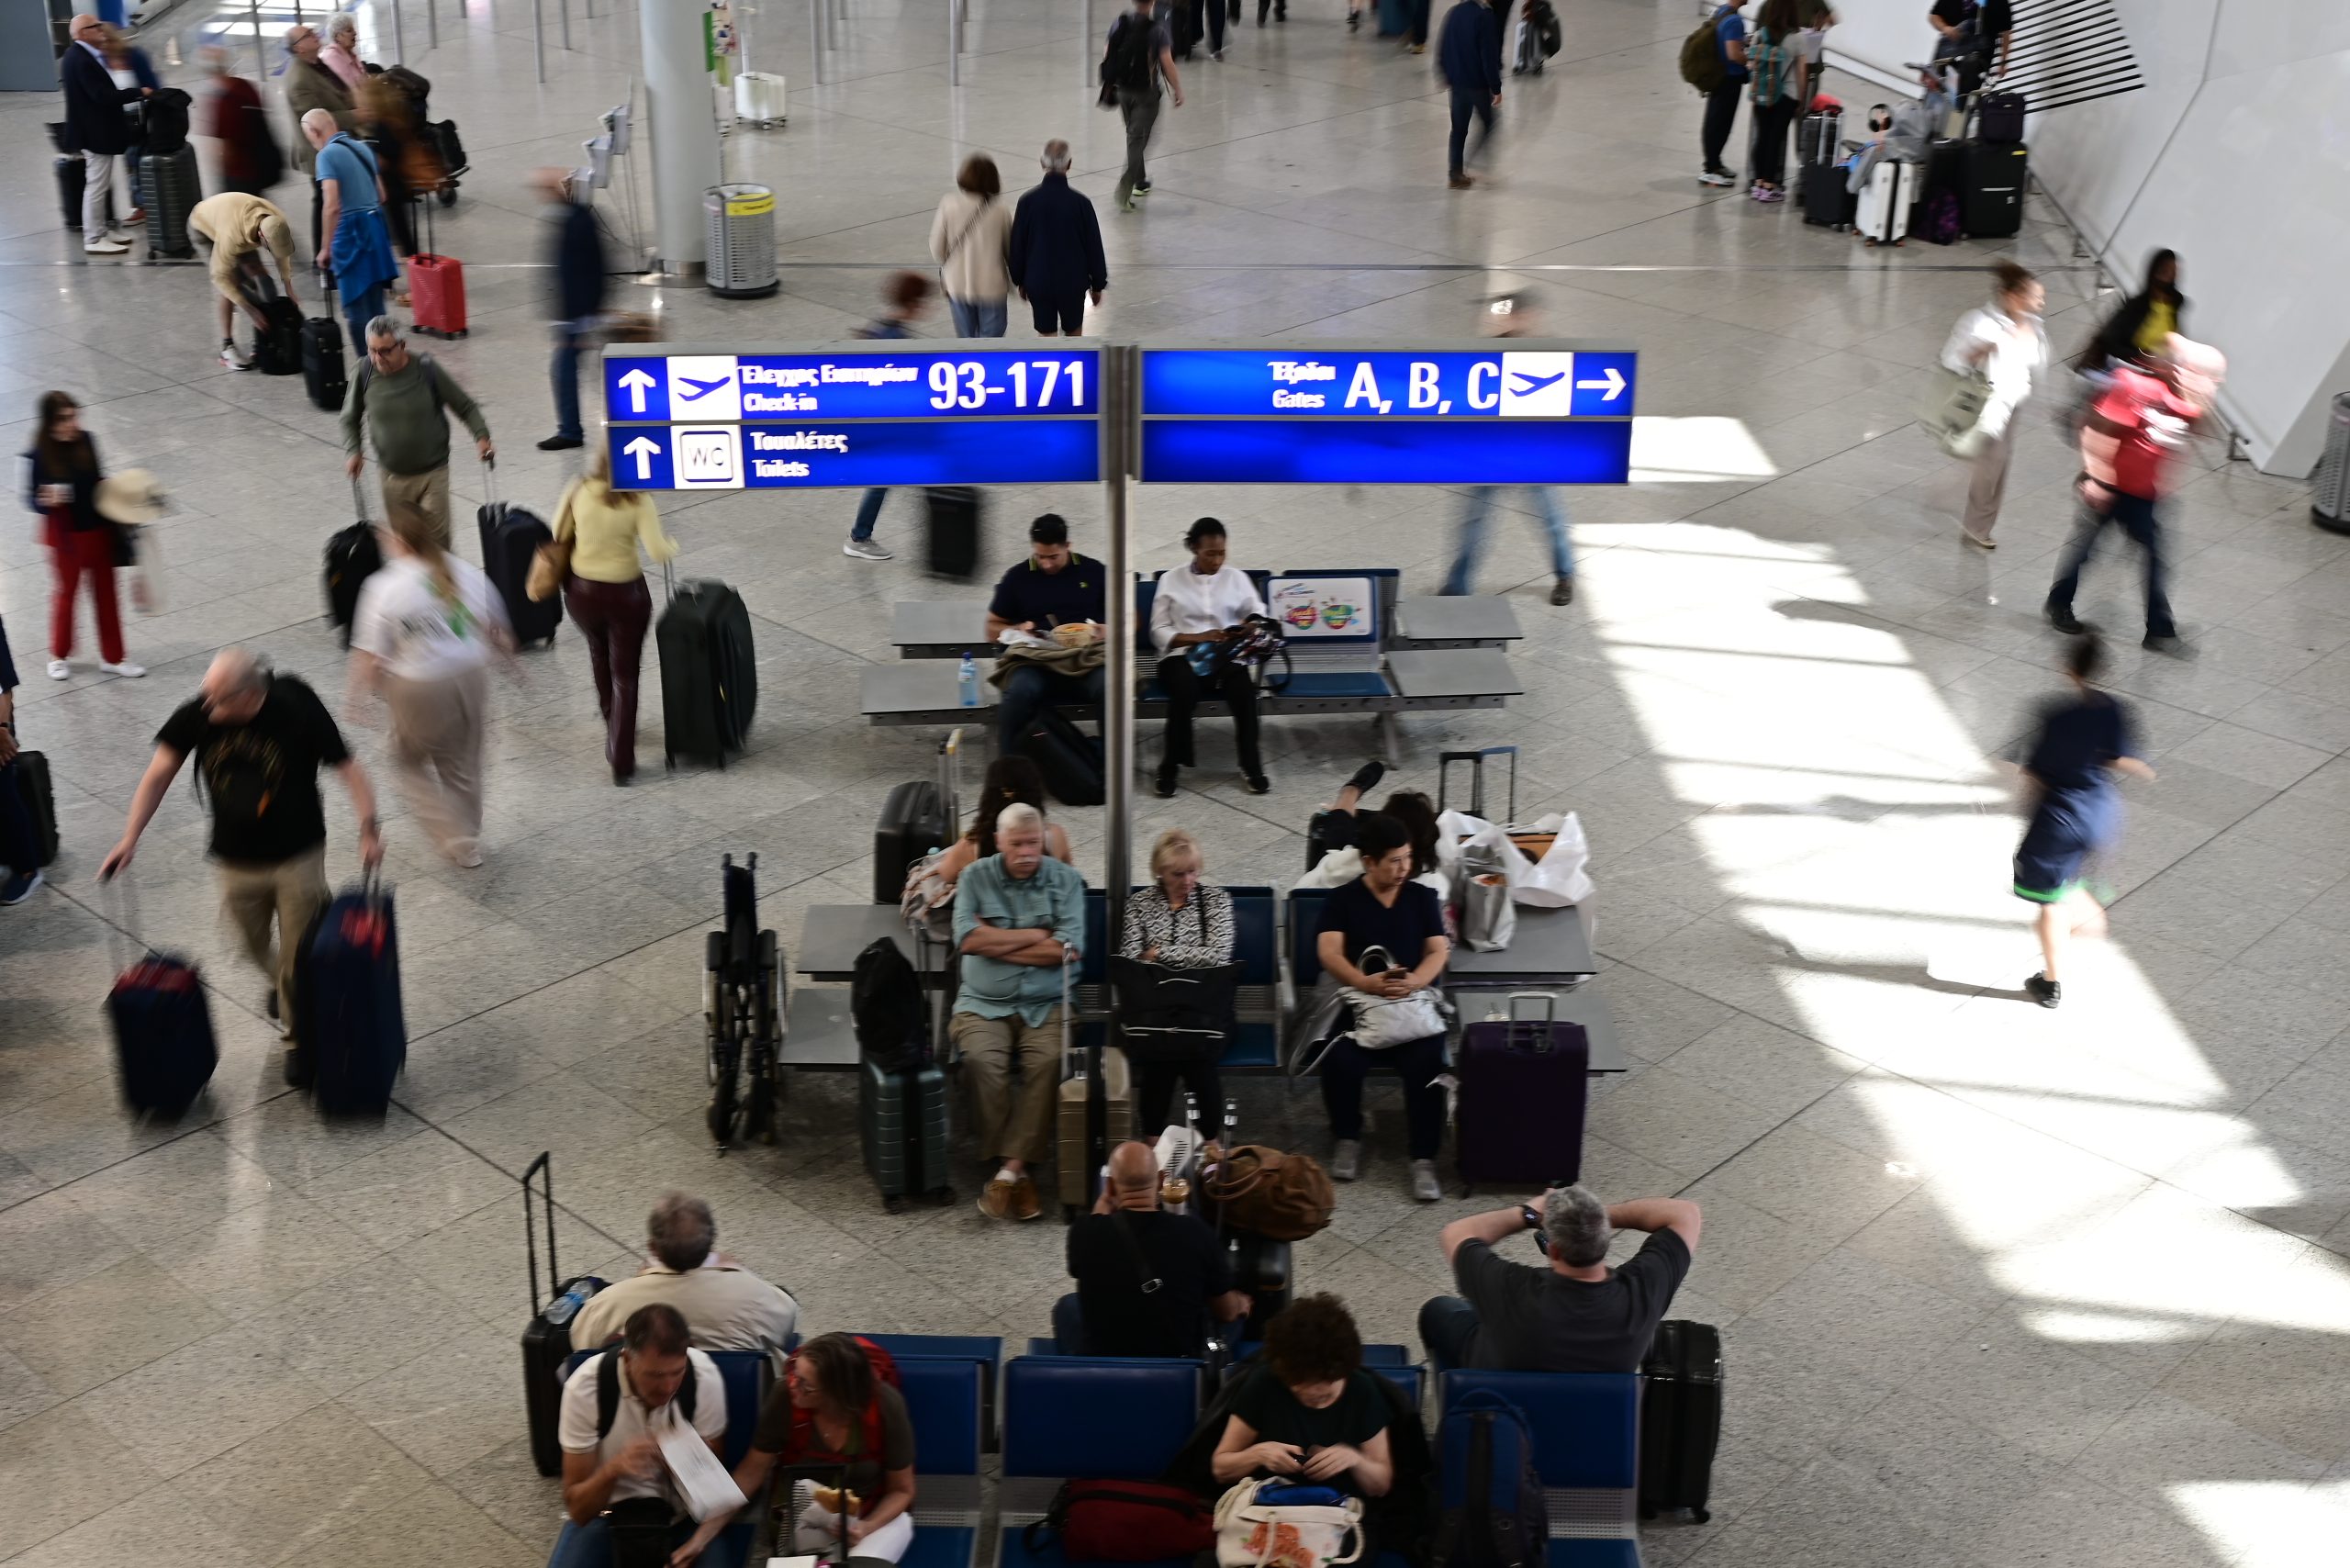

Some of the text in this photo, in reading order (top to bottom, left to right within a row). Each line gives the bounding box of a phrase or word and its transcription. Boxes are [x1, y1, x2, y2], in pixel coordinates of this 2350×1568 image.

[928, 361, 1084, 409] 93-171
[1344, 361, 1500, 414] A, B, C
[1272, 389, 1326, 409] Gates
[688, 447, 725, 466] WC
[751, 459, 811, 477] Toilets
